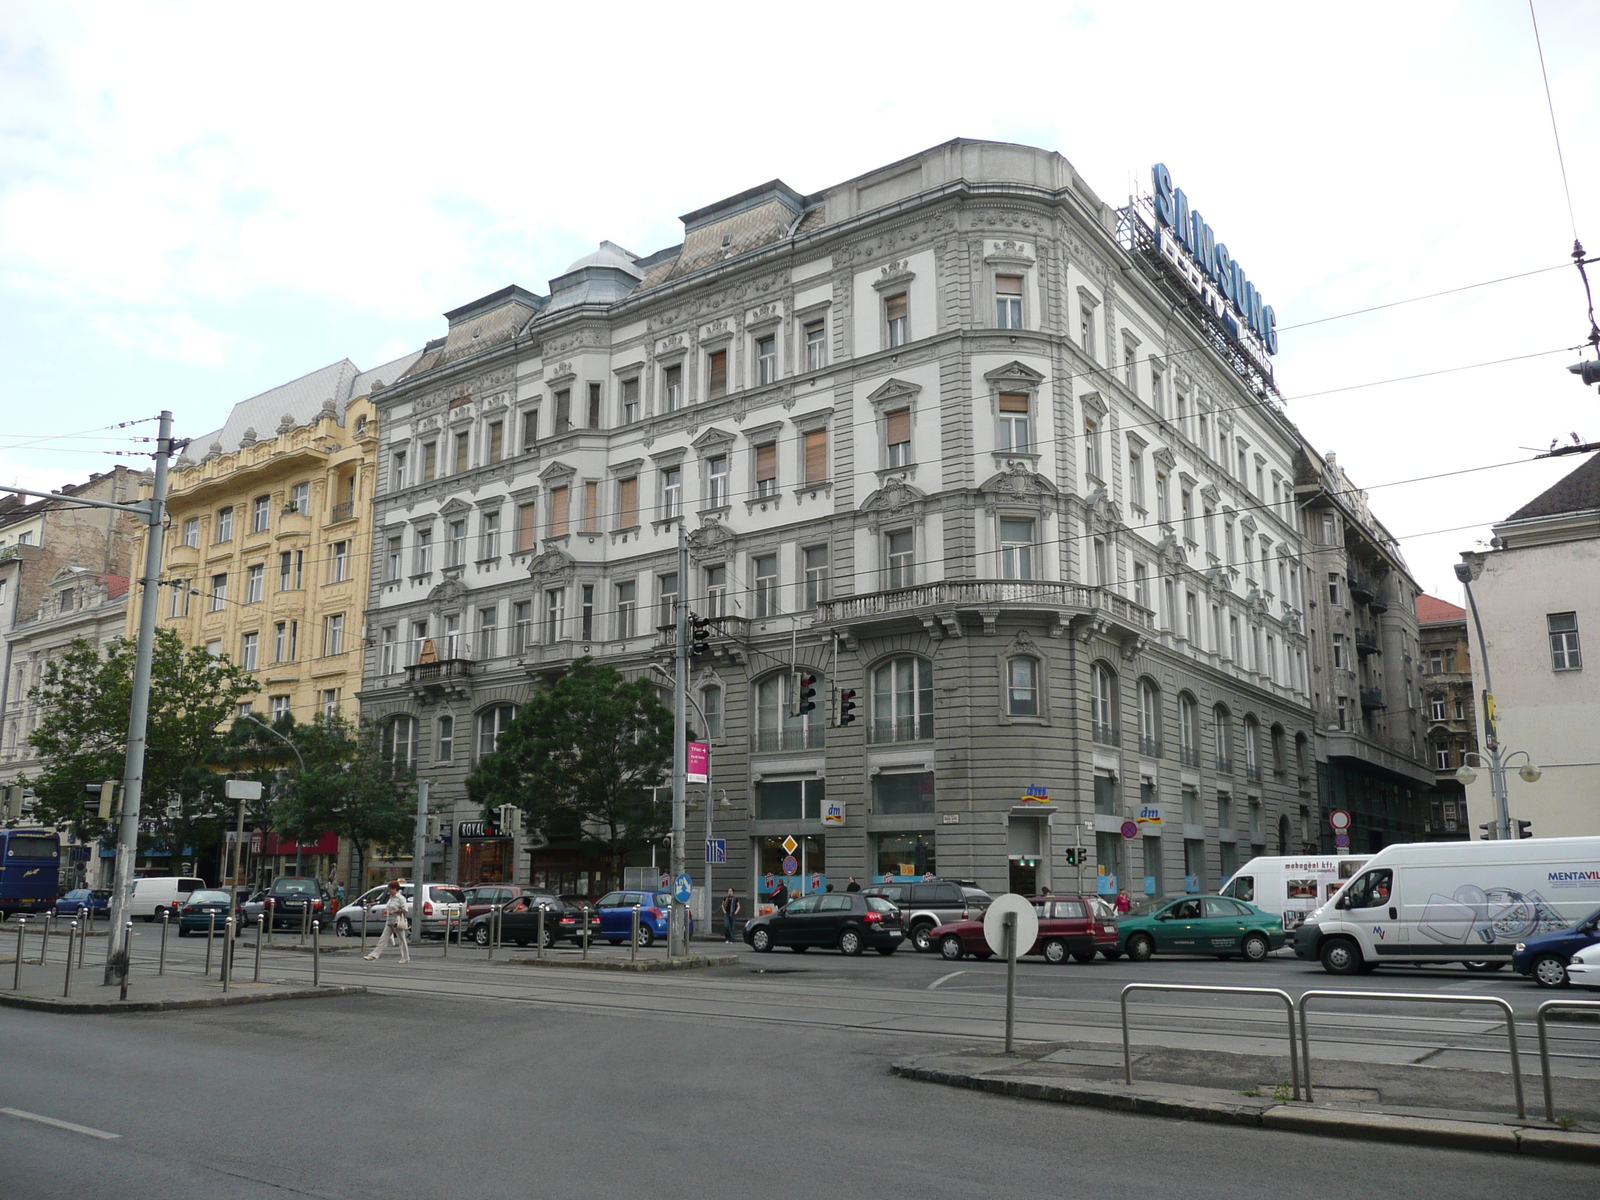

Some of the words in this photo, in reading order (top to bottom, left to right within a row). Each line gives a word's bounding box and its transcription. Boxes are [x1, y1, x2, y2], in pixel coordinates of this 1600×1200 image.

[1152, 163, 1279, 356] SAMSUNG
[1026, 783, 1047, 796] dm
[828, 803, 841, 816] dm
[1140, 806, 1159, 818] dm
[462, 823, 485, 836] ROYAL
[1321, 860, 1336, 869] kft.
